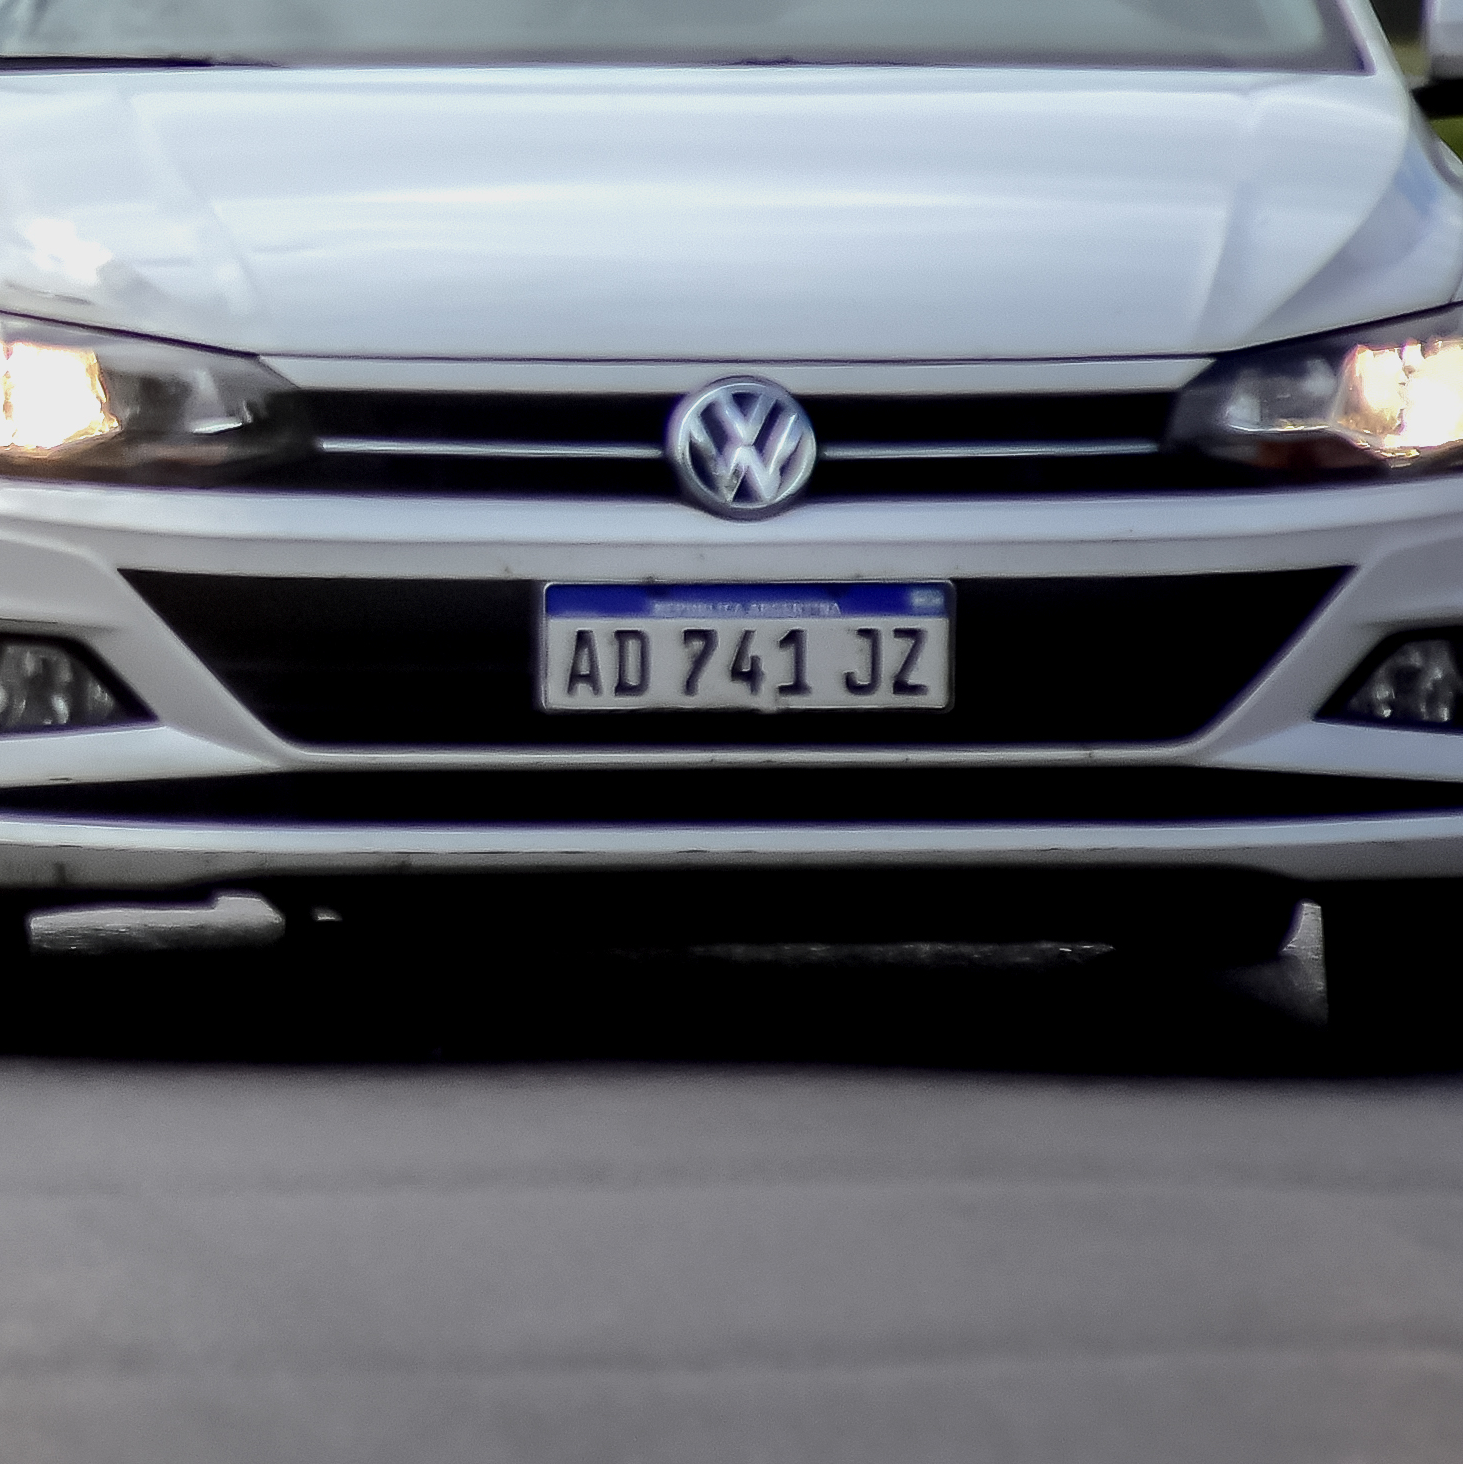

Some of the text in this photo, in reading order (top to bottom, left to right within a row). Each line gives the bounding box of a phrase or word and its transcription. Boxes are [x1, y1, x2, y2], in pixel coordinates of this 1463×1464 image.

[678, 382, 816, 509] VW
[567, 628, 929, 697] AD 741 JZ
